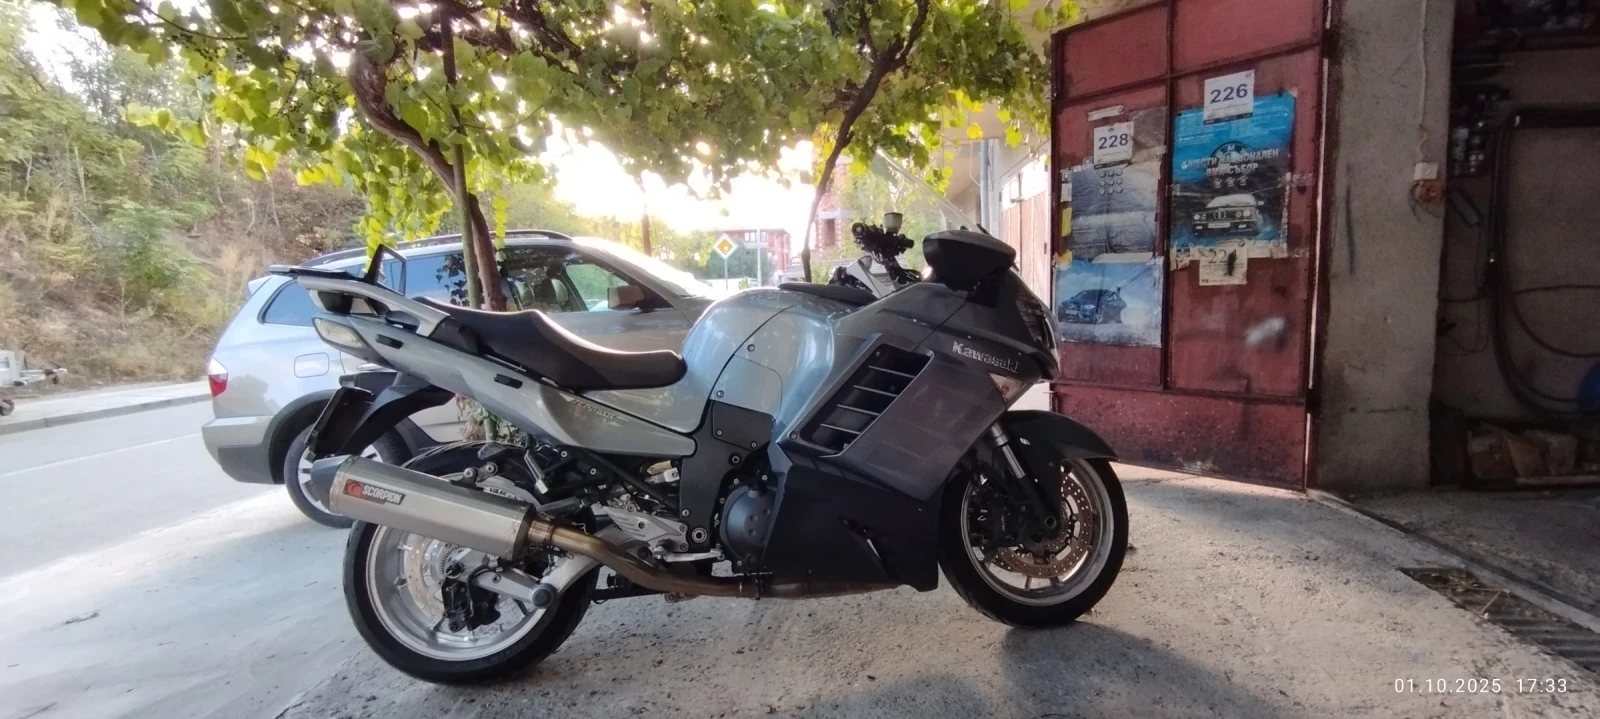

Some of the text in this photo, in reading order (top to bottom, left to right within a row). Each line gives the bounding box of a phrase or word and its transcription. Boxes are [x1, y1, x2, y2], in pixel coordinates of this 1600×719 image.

[1210, 83, 1248, 104] 226
[1098, 133, 1129, 150] 228
[952, 341, 1020, 373] Kawasaki
[362, 484, 402, 504] SCORPION
